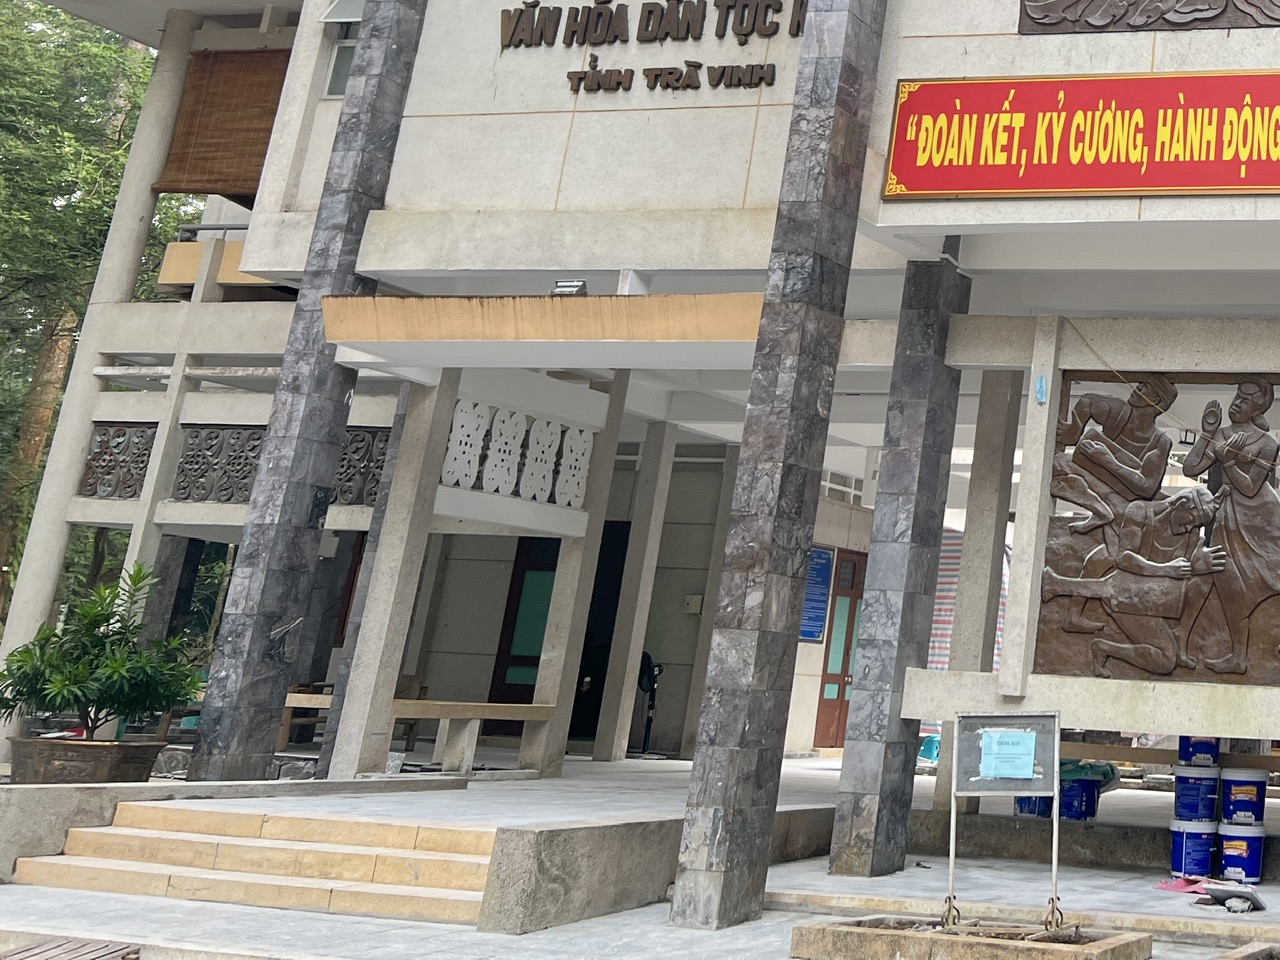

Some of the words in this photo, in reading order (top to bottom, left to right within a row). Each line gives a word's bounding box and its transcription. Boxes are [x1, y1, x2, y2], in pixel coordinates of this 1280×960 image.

[501, 0, 562, 48] VĂN
[566, 52, 635, 91] TỈNH
[643, 60, 704, 89] TRÀ
[706, 63, 777, 88] VINH
[979, 89, 1028, 178] KẾT,
[1033, 90, 1067, 165] KỶ
[1069, 99, 1149, 176] CƯƠNG,
[1154, 92, 1220, 163] HÀNH
